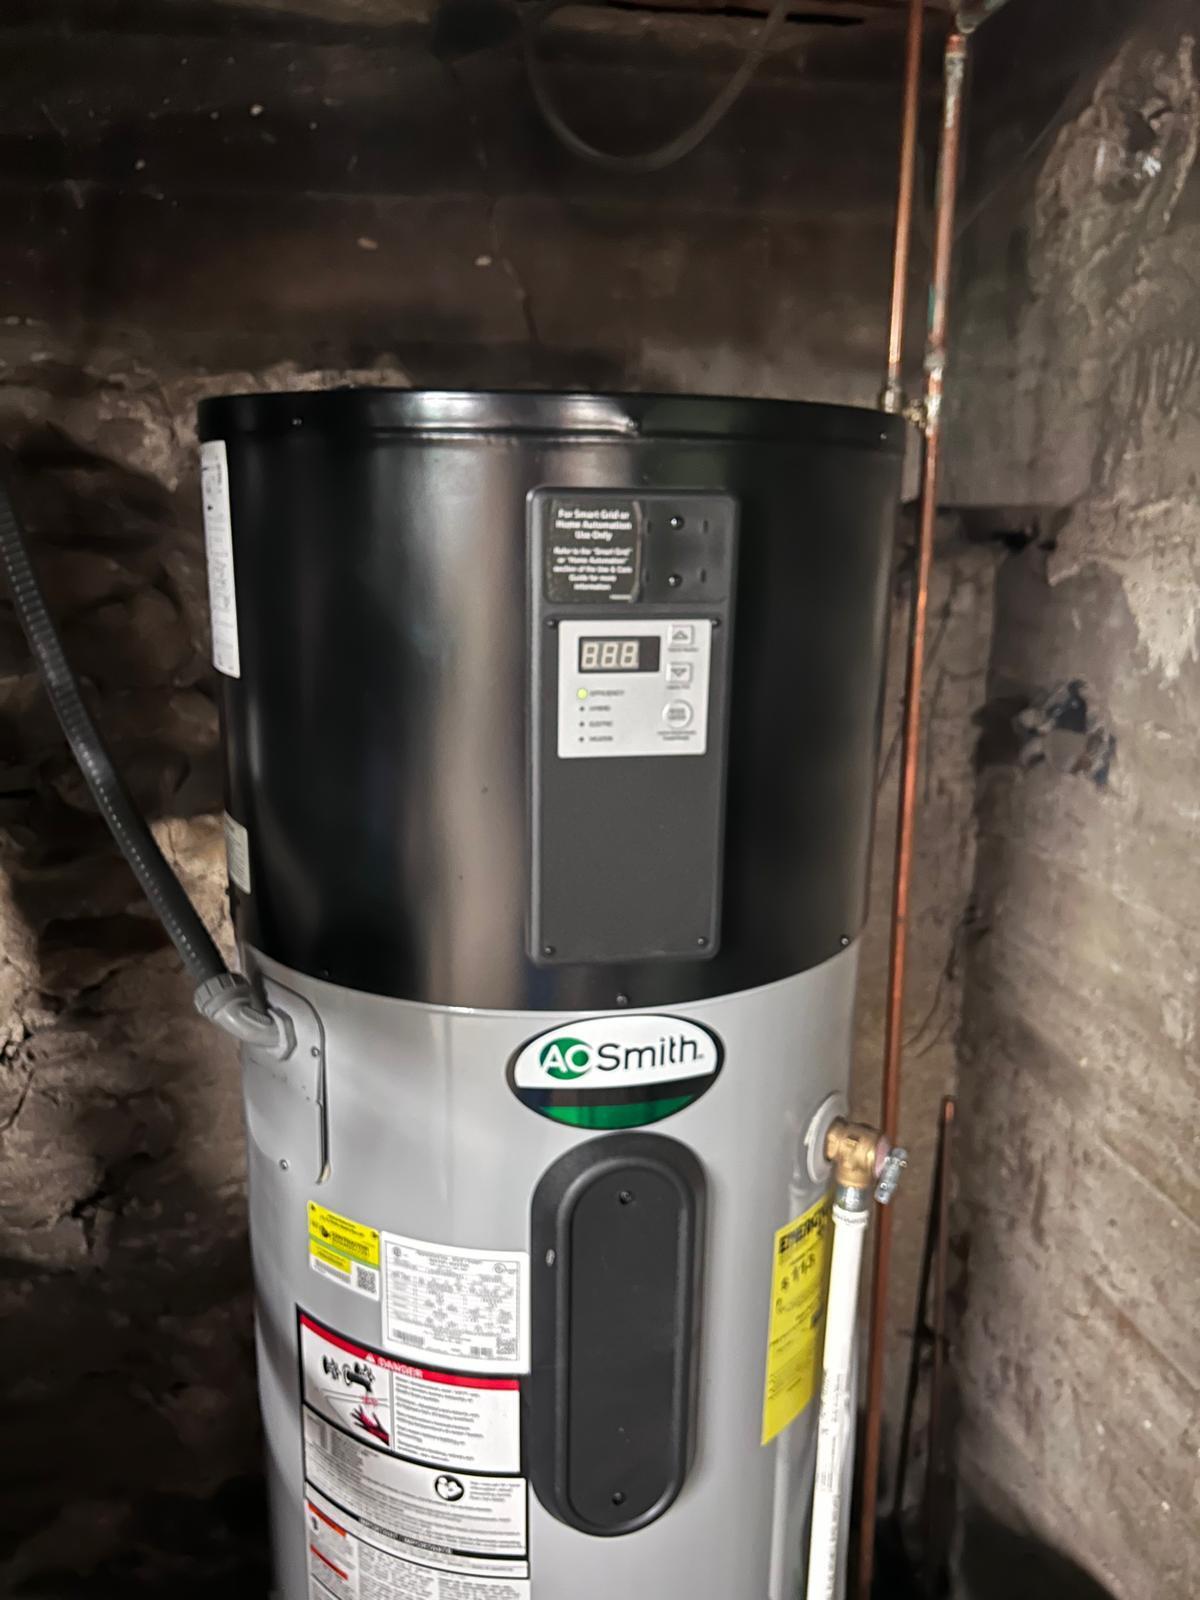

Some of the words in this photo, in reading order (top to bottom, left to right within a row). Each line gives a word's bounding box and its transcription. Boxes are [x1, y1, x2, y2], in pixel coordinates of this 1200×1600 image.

[558, 508, 573, 519] For
[574, 508, 600, 519] Smart
[600, 508, 620, 520] Grid
[592, 530, 613, 542] Only
[597, 1034, 698, 1071] Smith
